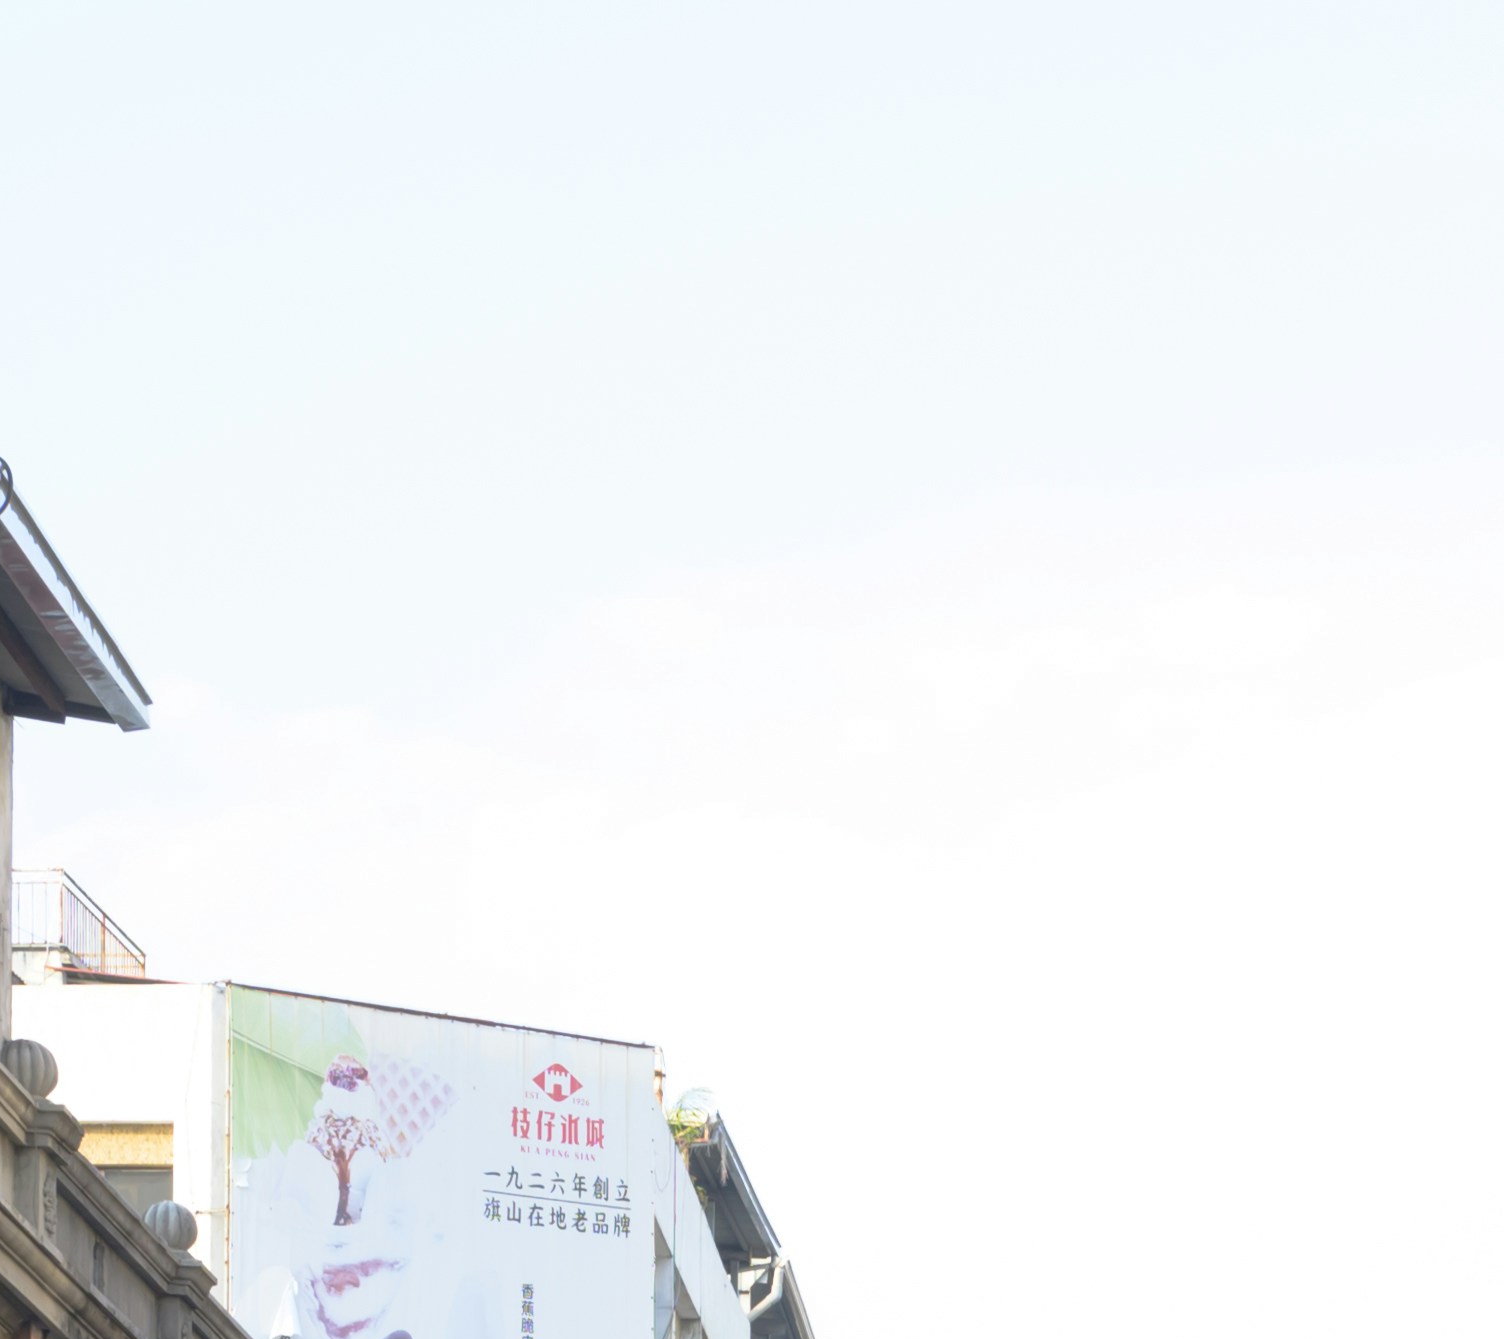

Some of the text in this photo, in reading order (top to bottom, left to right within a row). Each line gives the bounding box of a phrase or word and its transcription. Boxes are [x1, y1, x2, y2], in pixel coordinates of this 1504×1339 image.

[484, 1166, 631, 1202] 一九二六年創立
[484, 1197, 631, 1239] 旗山在地老品牌
